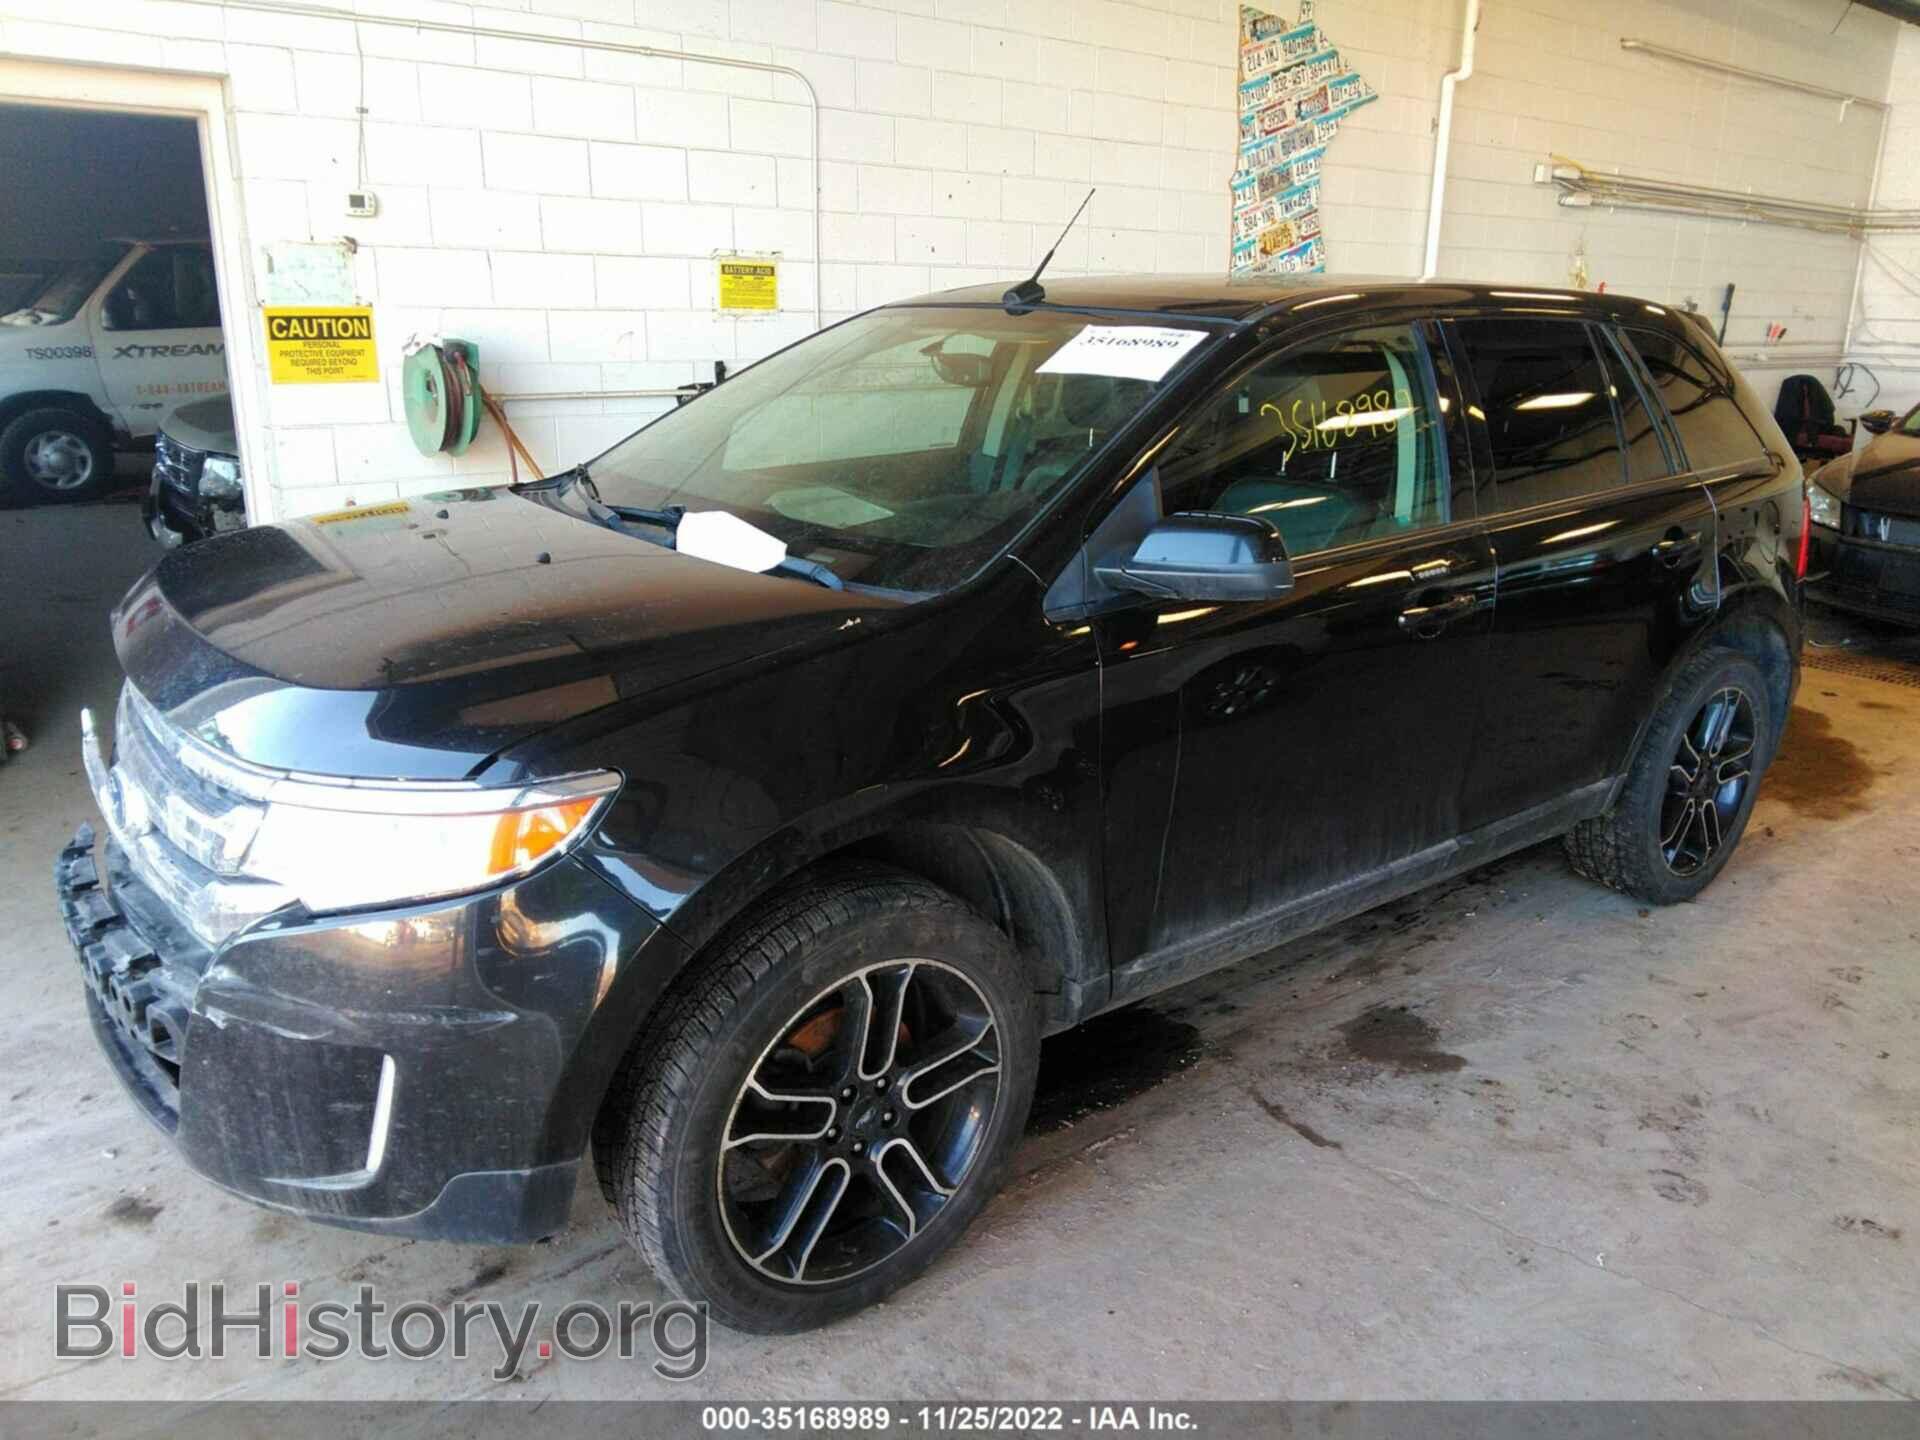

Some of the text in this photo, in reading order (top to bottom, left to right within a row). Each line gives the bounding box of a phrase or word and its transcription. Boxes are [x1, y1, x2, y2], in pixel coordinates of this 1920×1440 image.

[271, 318, 369, 338] CAUTION
[280, 349, 365, 358] PROTECTIVE EQUIPMENT
[291, 358, 357, 366] REQUIRED BEYOND
[306, 367, 344, 375] THIS POINT
